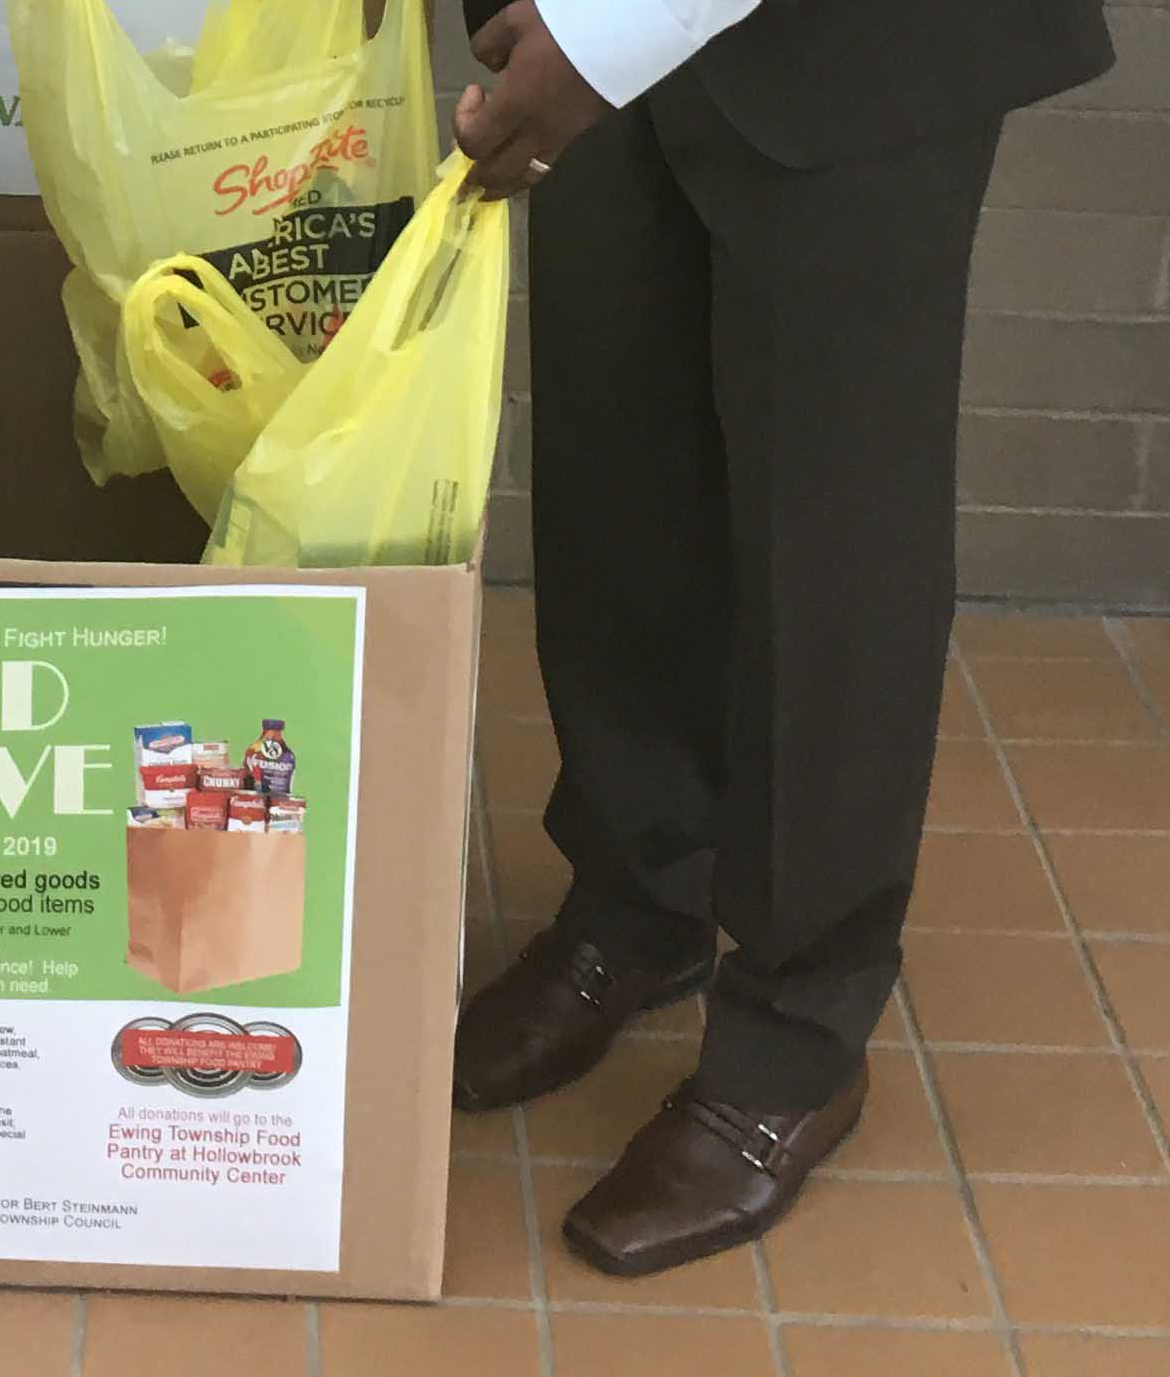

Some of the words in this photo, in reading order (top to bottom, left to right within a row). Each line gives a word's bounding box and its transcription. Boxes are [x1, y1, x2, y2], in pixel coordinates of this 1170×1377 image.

[151, 150, 181, 164] PLEASE
[184, 140, 221, 156] RETURN
[225, 138, 238, 147] TO
[240, 134, 248, 144] A
[250, 117, 319, 140] PARTICIPATING
[272, 212, 376, 246] RICA'S
[240, 279, 371, 310] STOME
[4, 627, 66, 647] FIGHT
[72, 626, 167, 647] HUNGER!
[3, 837, 57, 856] 2019
[35, 871, 100, 893] goods
[40, 894, 95, 913] items
[8, 925, 30, 935] and
[34, 925, 71, 936] Lower
[42, 960, 79, 978] Help
[118, 1107, 135, 1119] All
[139, 1108, 204, 1122] donations
[209, 1111, 230, 1123] will
[234, 1113, 251, 1127] go
[255, 1114, 267, 1125] to
[271, 1114, 292, 1127] the
[109, 1124, 162, 1143] Ewing
[168, 1126, 250, 1146] Township
[257, 1131, 300, 1147] Food
[107, 1144, 163, 1162] Pantry
[170, 1148, 186, 1161] at
[193, 1149, 301, 1167] Hollowbrook
[121, 1164, 219, 1185] Community
[227, 1168, 286, 1185] Center
[24, 1199, 57, 1211] BERT
[62, 1200, 137, 1215] STEINMANN
[64, 1215, 122, 1229] COUNCIL
